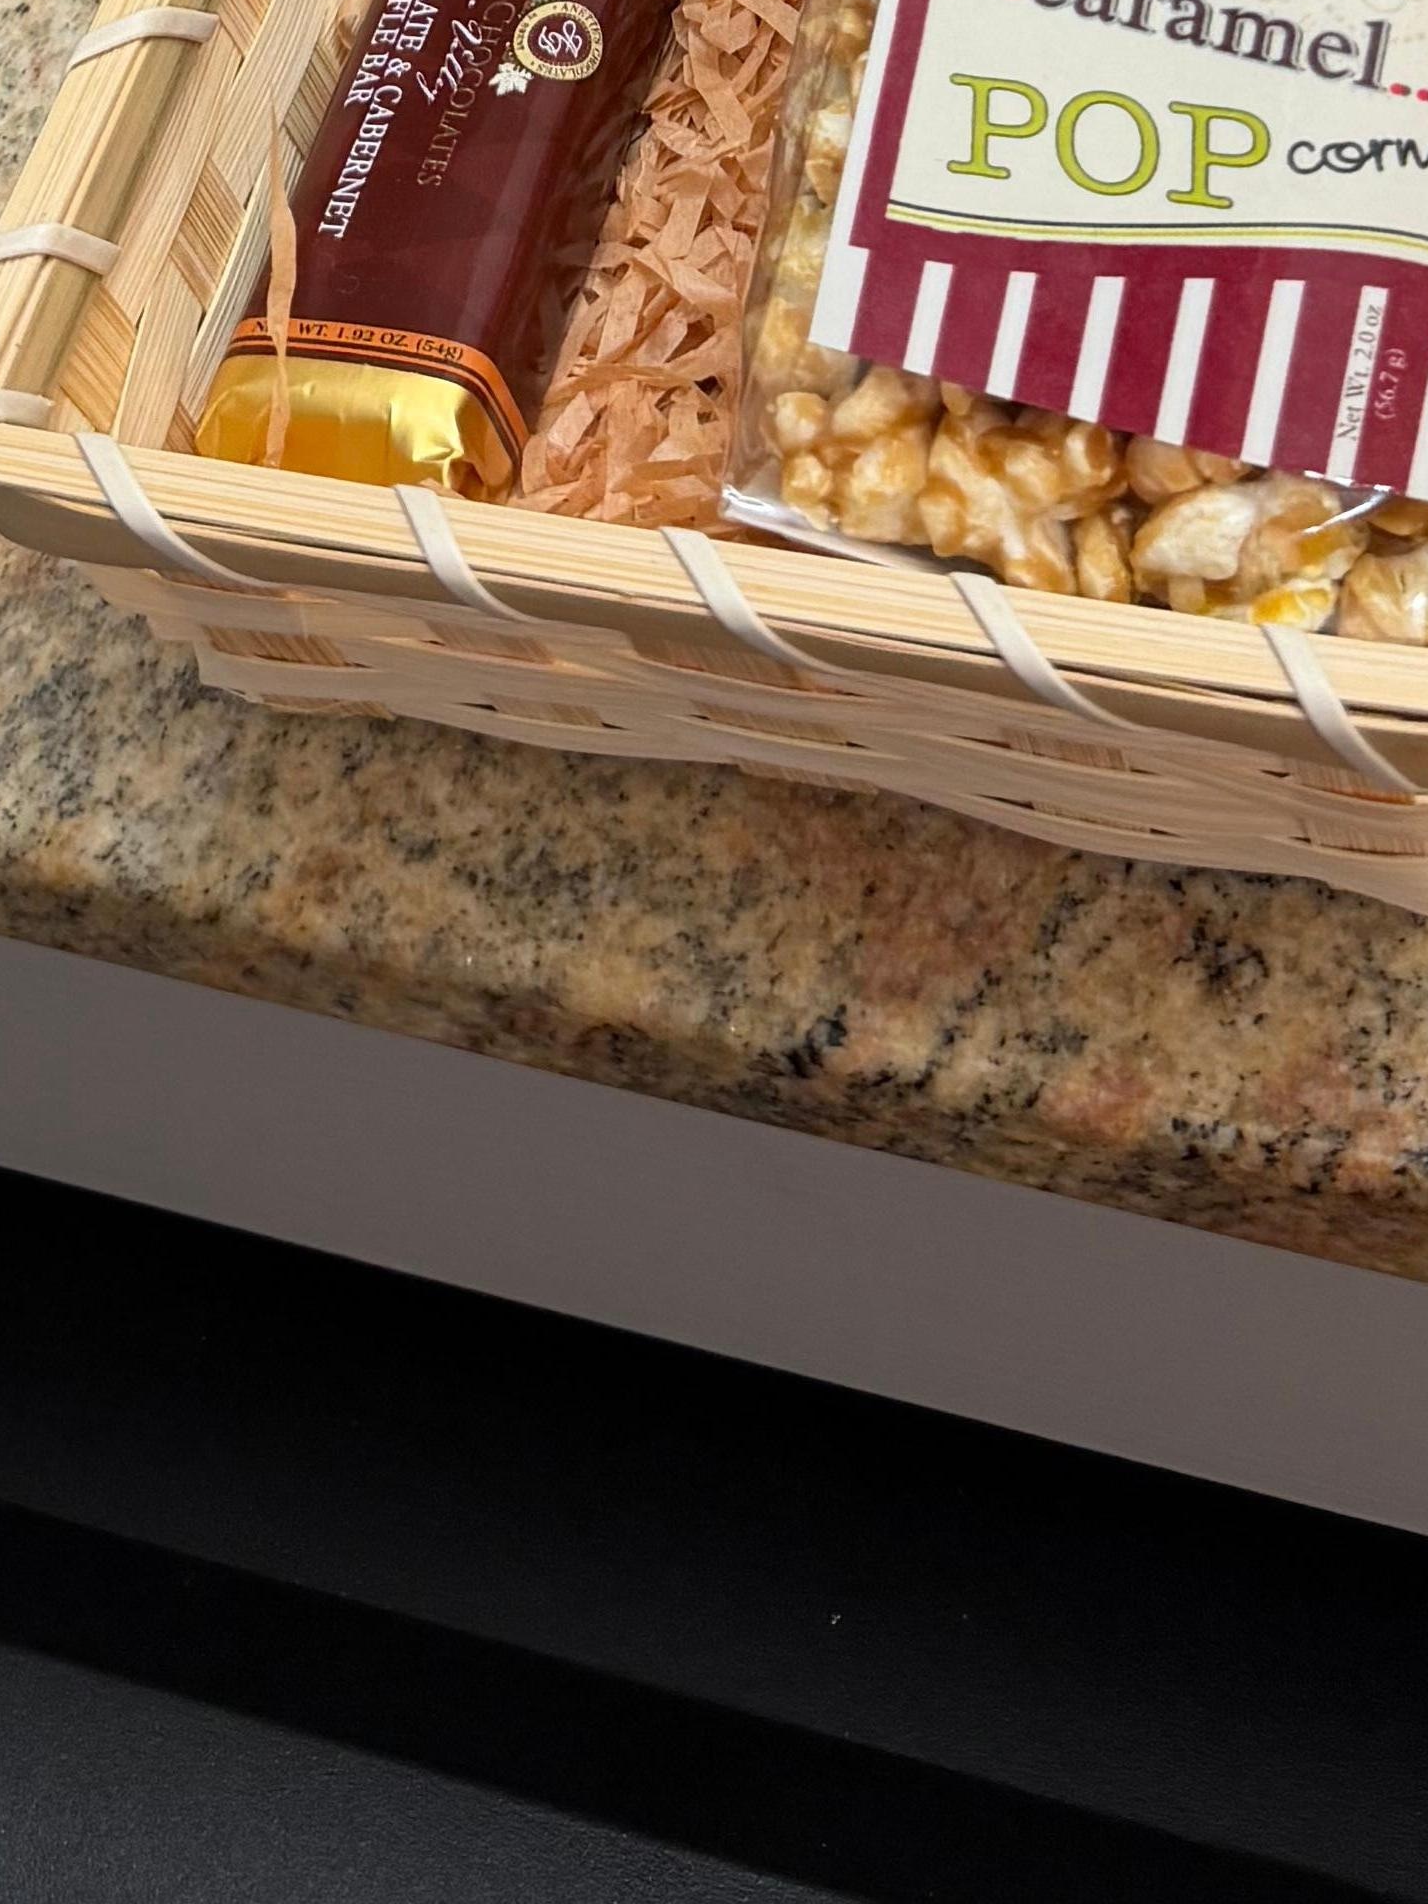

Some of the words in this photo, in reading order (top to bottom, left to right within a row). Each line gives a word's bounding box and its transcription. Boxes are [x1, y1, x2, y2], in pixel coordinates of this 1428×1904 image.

[343, 50, 389, 110] BAR
[384, 56, 413, 80] &
[414, 17, 483, 107] Valley
[317, 82, 404, 241] CABERNET
[946, 72, 1272, 211] POP
[1364, 304, 1383, 328] oz
[298, 321, 328, 338] WT.
[336, 326, 376, 342] 1.92
[379, 331, 409, 349] OZ.
[415, 338, 464, 361] (54g)
[1354, 330, 1376, 361] 2.0
[1384, 347, 1409, 370] g)
[1374, 370, 1400, 421] (56.7
[1336, 404, 1363, 442] Net
